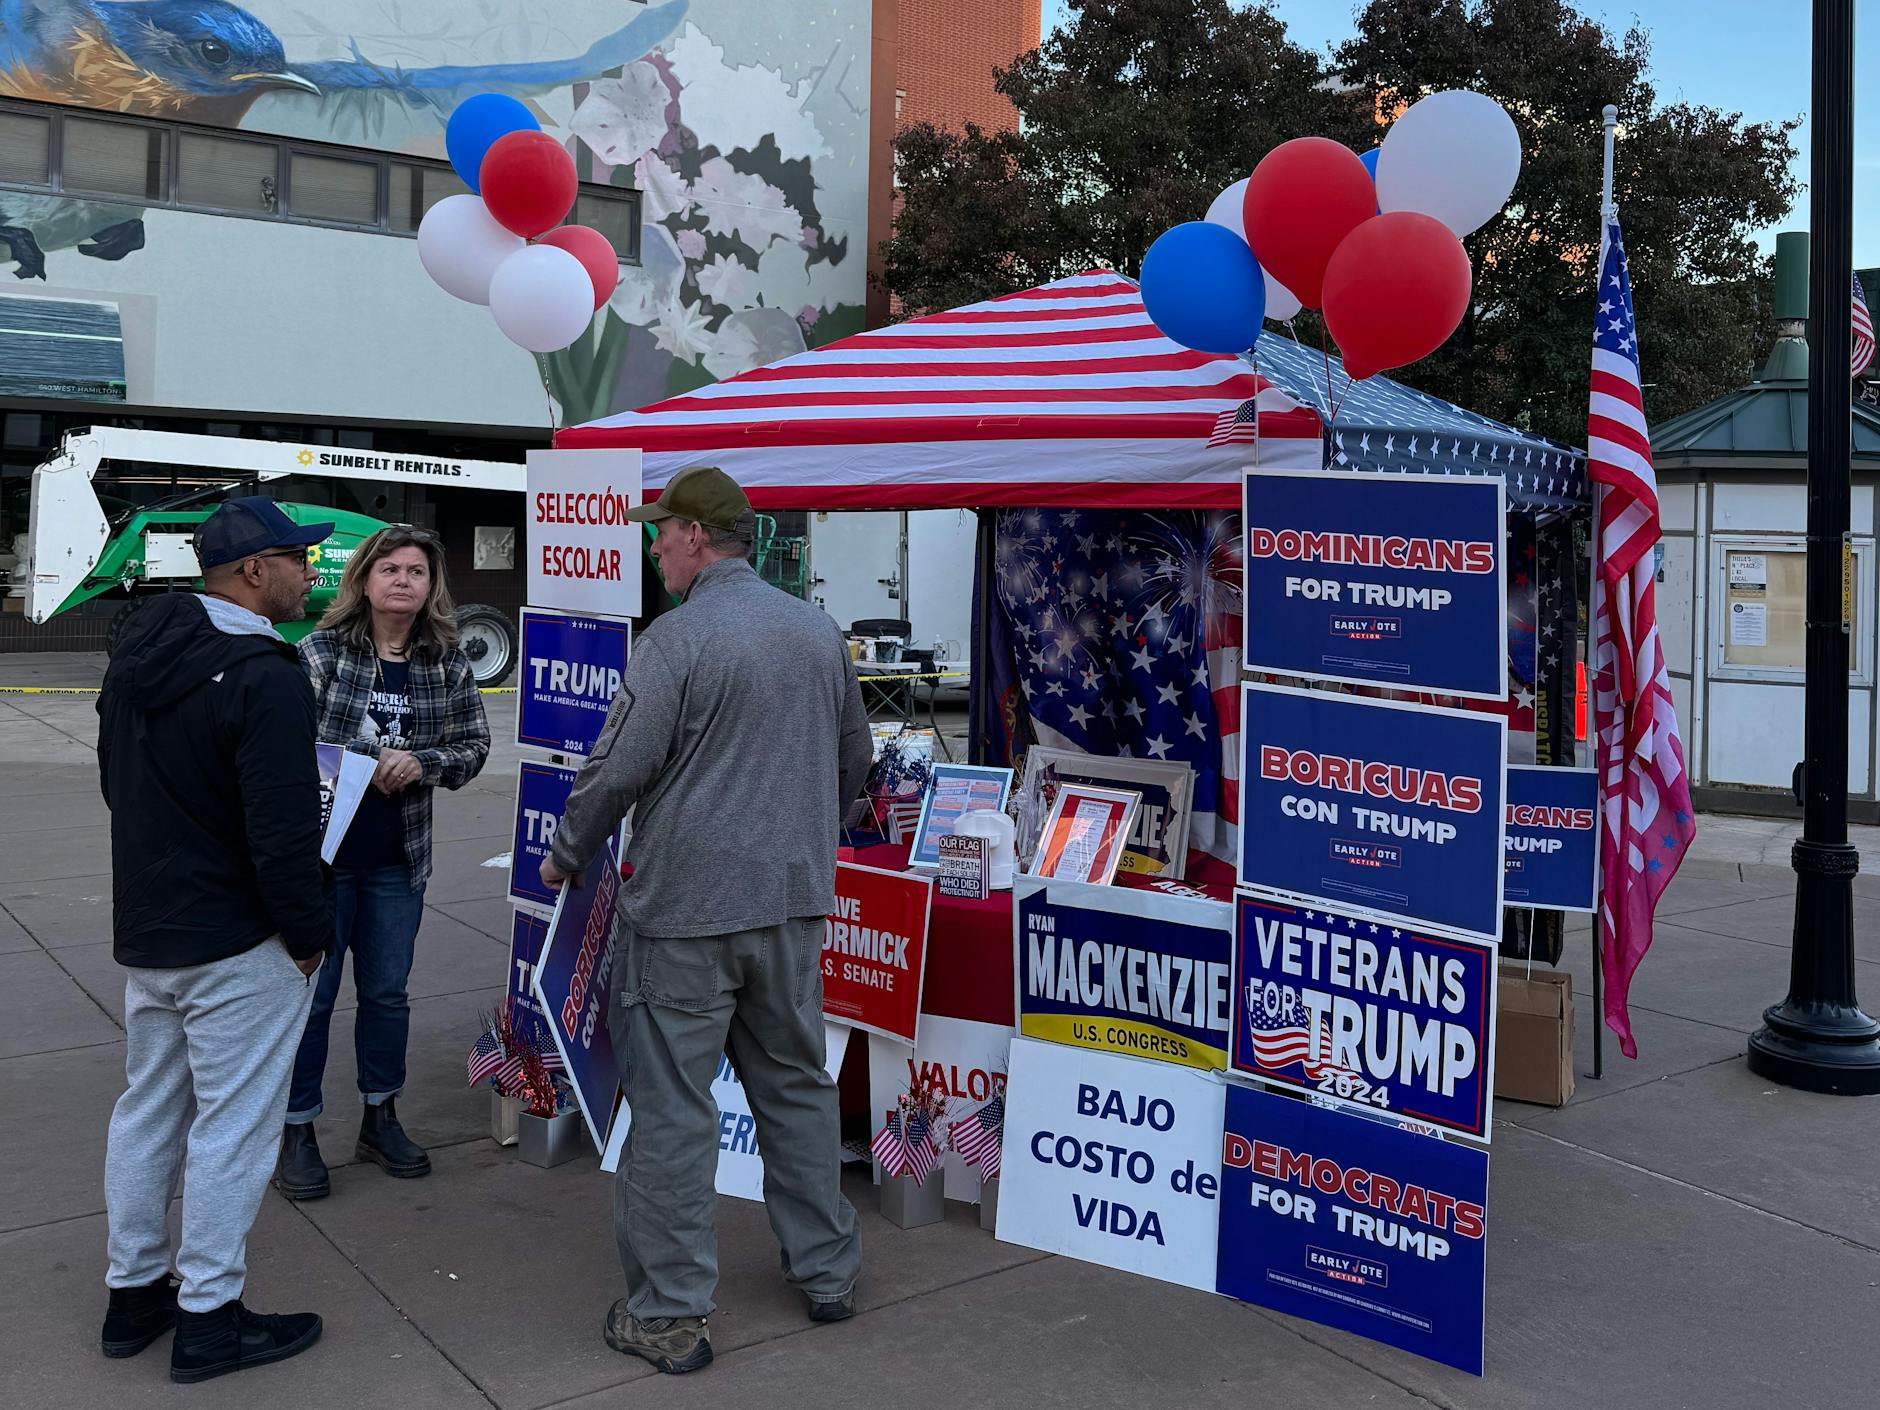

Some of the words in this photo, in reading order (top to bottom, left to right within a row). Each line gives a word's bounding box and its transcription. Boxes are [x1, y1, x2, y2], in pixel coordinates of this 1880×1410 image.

[77, 387, 118, 395] HAMILTON
[319, 453, 391, 471] SUNBELT
[394, 459, 462, 477] RENTALS
[536, 485, 629, 526] SELECCIÓN
[542, 545, 621, 581] ESCOLAR
[1250, 527, 1495, 574] DOMINICANS
[1285, 576, 1341, 602] FOR
[1347, 581, 1452, 611] TRUMP
[1334, 620, 1368, 631] EARLY
[530, 657, 621, 701] TRUMP
[534, 693, 552, 703] MAKE
[553, 697, 579, 708] AMERICA
[580, 701, 599, 711] GREAT
[564, 739, 583, 752] 2024
[1260, 744, 1483, 814] BORICUAS
[524, 808, 563, 846] TR
[1280, 795, 1339, 825] CON
[1352, 806, 1457, 845] TRUMP
[1505, 804, 1594, 831] ICANS
[525, 845, 542, 855] MAKE
[940, 837, 957, 849] OUR
[959, 840, 980, 851] FLAG
[1334, 844, 1368, 857] EARLY
[950, 859, 980, 872] BREATH
[1350, 858, 1381, 867] ACTION
[940, 876, 959, 888] WHO
[960, 878, 980, 890] DIED
[940, 887, 974, 897] PROTECTING
[1028, 913, 1055, 932] RYAN
[561, 860, 615, 1043] BORICUAS
[596, 911, 621, 992] TRUMP
[1254, 916, 1466, 1014] VETERANS
[843, 962, 894, 992] SENATE
[1028, 932, 1229, 1032] MACKENZIE
[1073, 1022, 1102, 1043] U.S.
[1106, 1027, 1189, 1058] CONGRESS
[1249, 976, 1297, 1023] FOR
[1301, 987, 1476, 1097] TRUMP
[1317, 1070, 1390, 1108] 2024
[1077, 1083, 1175, 1132] BAJO
[1030, 1130, 1155, 1184] COSTO
[1170, 1160, 1218, 1200] de
[1223, 1132, 1485, 1240] DEMOCRATS
[1072, 1193, 1166, 1247] VIDA
[1251, 1182, 1317, 1224] FOR
[1332, 1204, 1450, 1262] TRUMP
[1310, 1252, 1350, 1270] EARLY
[1327, 1271, 1365, 1285] ACTION
